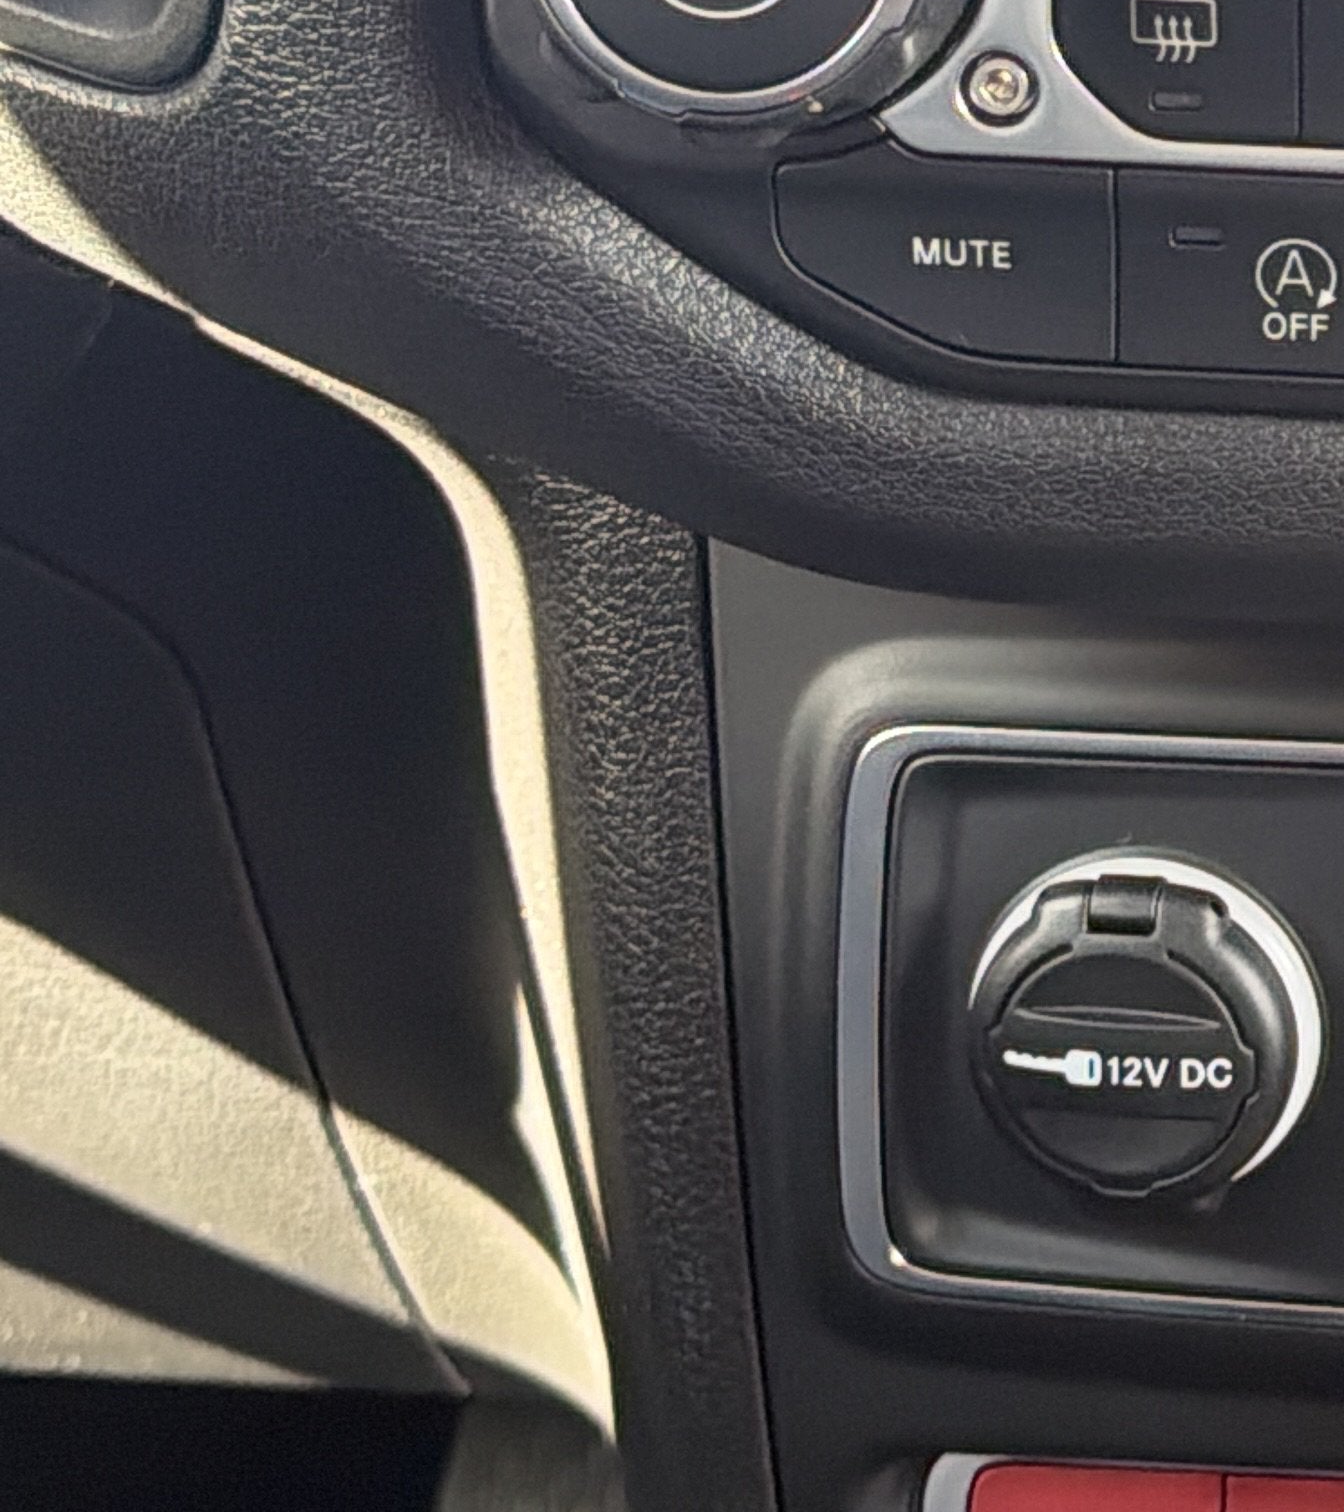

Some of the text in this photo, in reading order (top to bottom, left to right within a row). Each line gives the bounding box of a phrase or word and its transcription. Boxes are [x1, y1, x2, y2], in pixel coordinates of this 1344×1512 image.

[911, 236, 1013, 270] MUTE
[1261, 311, 1330, 342] OFF
[1106, 1056, 1233, 1089] 12V DC
